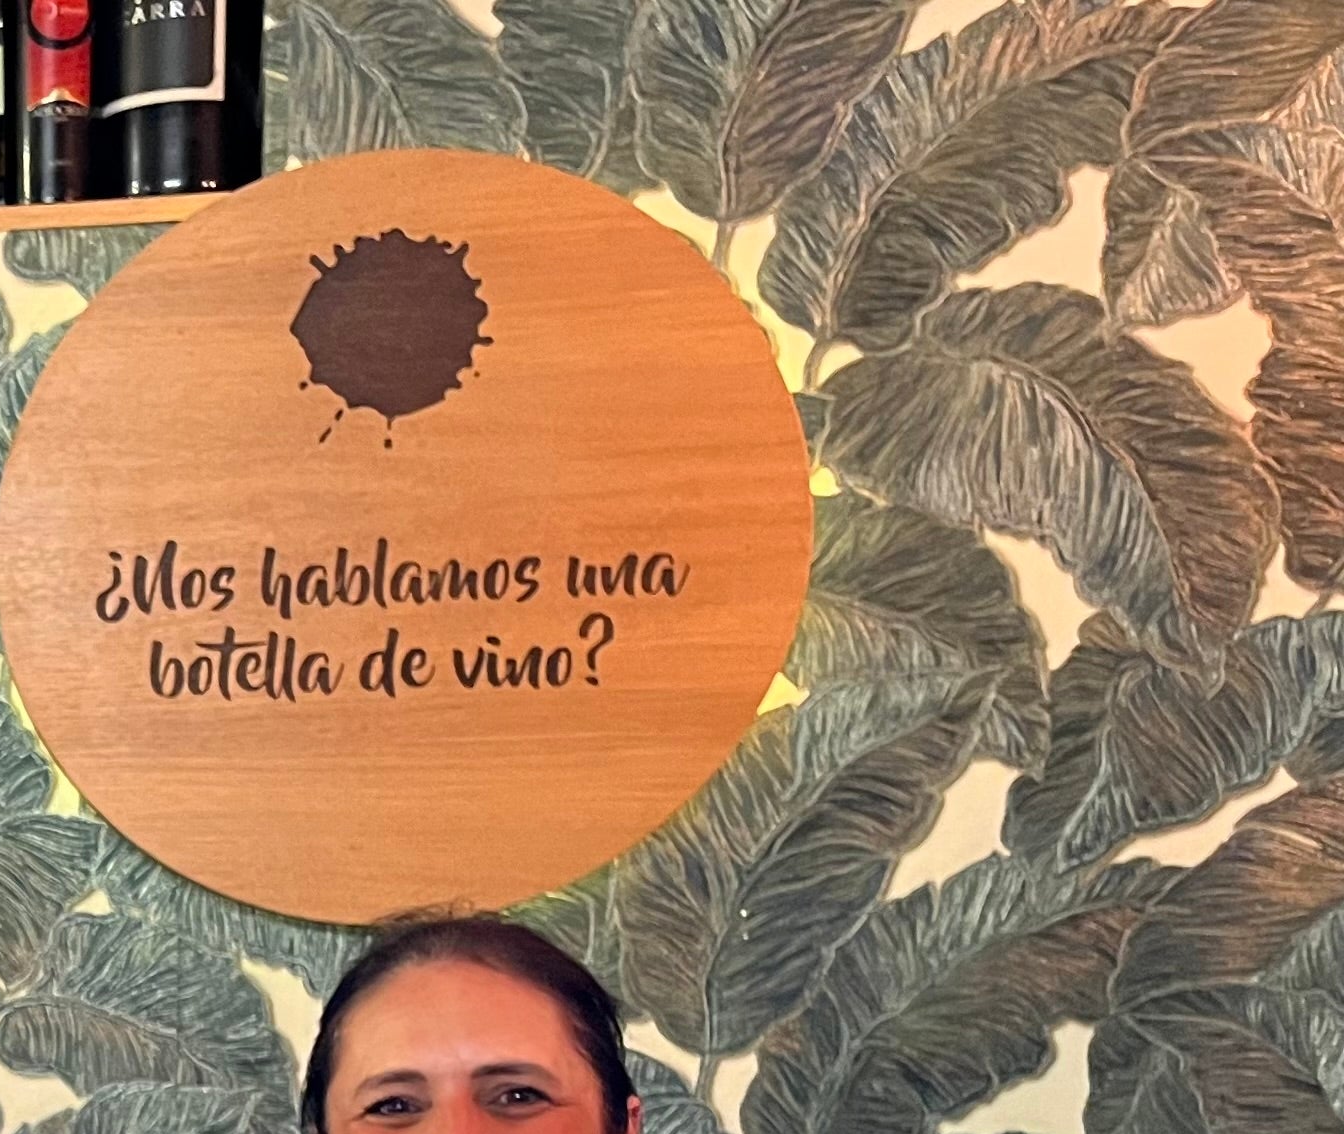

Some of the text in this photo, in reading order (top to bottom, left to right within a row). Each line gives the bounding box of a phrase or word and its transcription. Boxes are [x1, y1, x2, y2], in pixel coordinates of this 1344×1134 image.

[95, 536, 692, 624] ¿Nos hablamos una
[149, 611, 615, 704] botella de vino?
